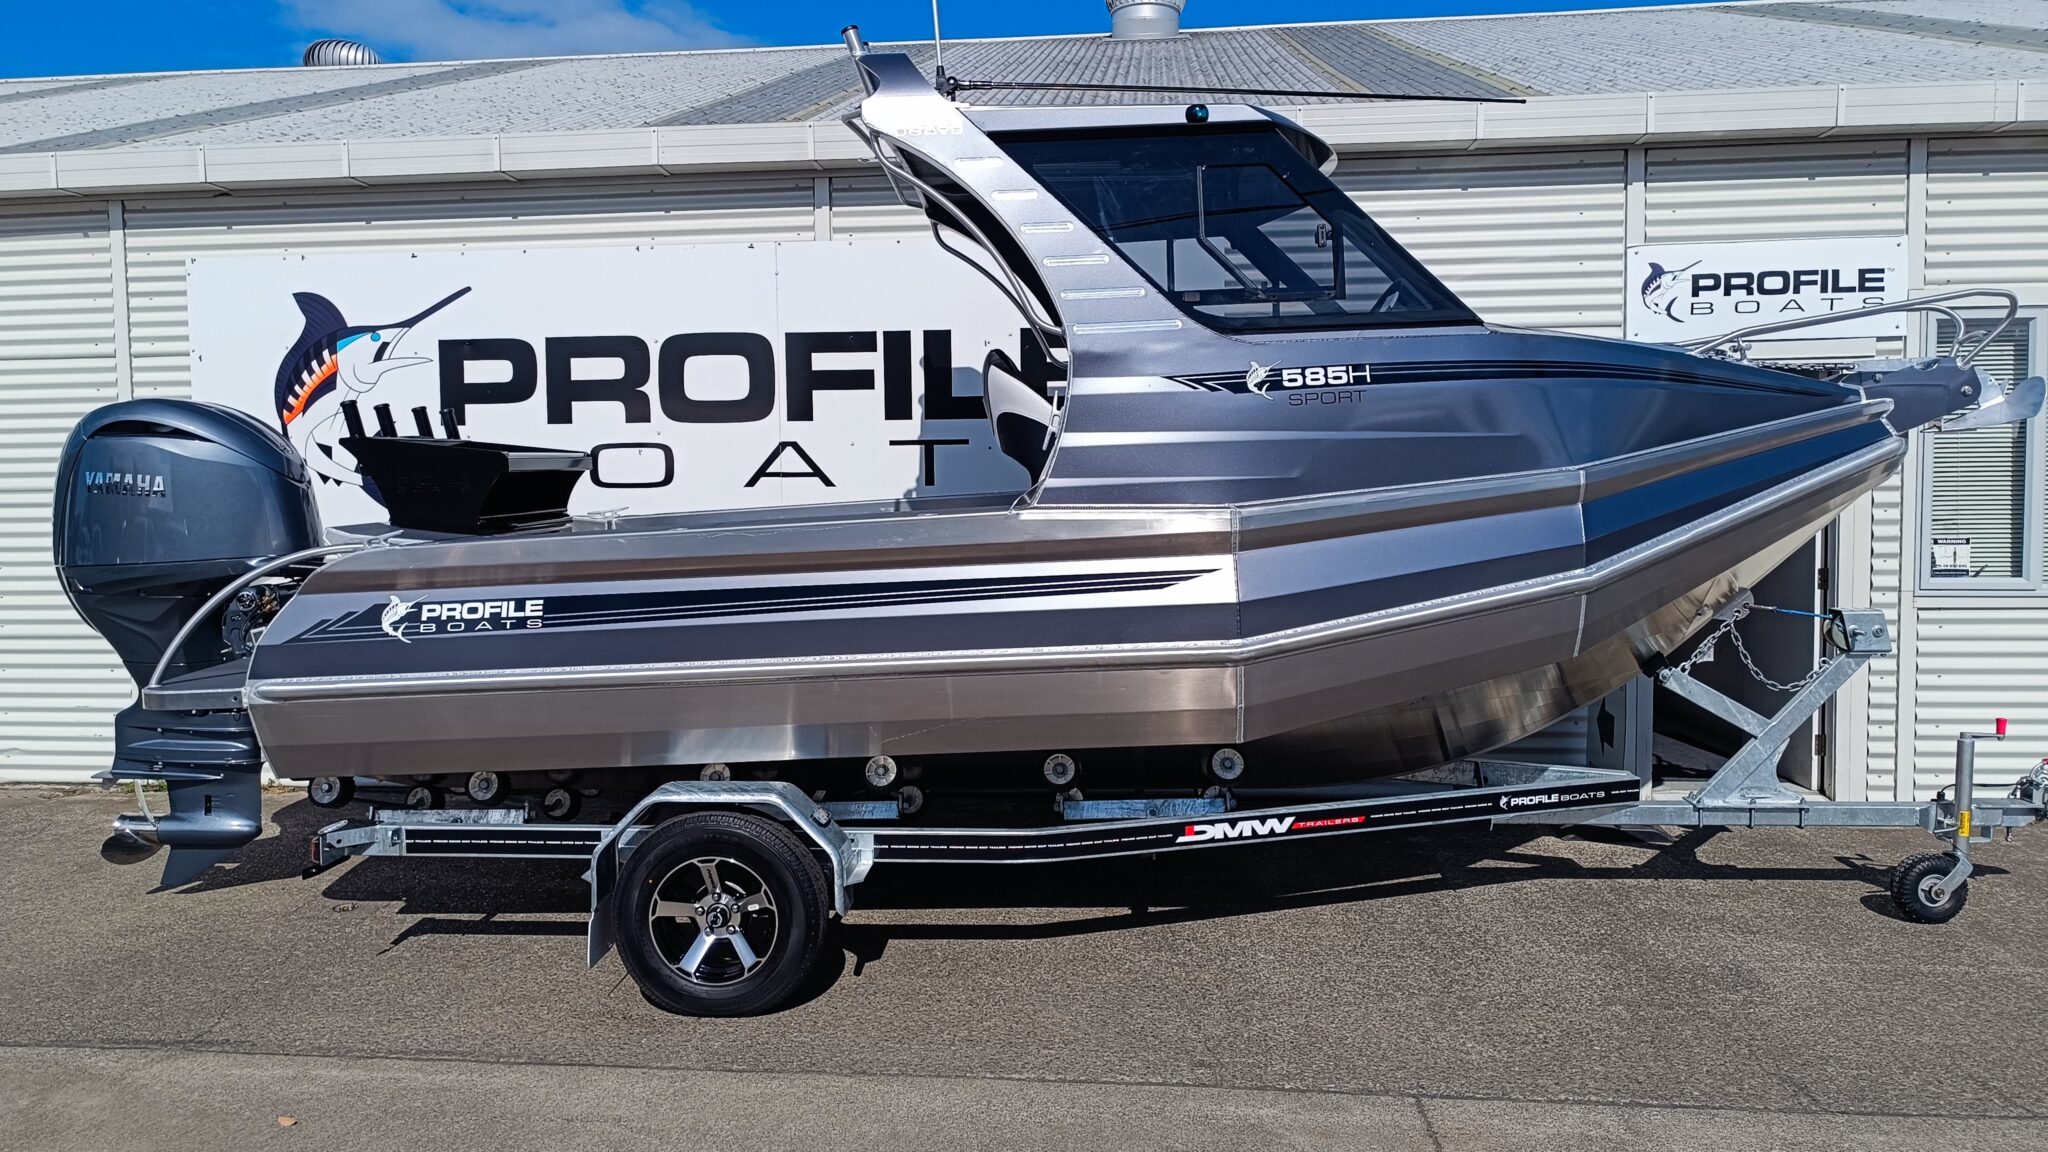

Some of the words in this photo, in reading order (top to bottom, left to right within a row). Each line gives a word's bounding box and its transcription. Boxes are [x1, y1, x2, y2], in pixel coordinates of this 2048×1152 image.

[1691, 268, 1885, 297] PROFILE
[1690, 296, 1885, 315] BOATS
[1281, 364, 1371, 388] 585H
[1288, 390, 1367, 406] SPORT
[85, 471, 166, 497] YAMAHA
[421, 599, 544, 621] PROFILE
[419, 618, 544, 633] BOATS
[1510, 793, 1560, 807] PROFILE
[1560, 791, 1606, 801] BOATS
[1175, 816, 1296, 843] DMW
[1299, 817, 1360, 828] TRAILERS
